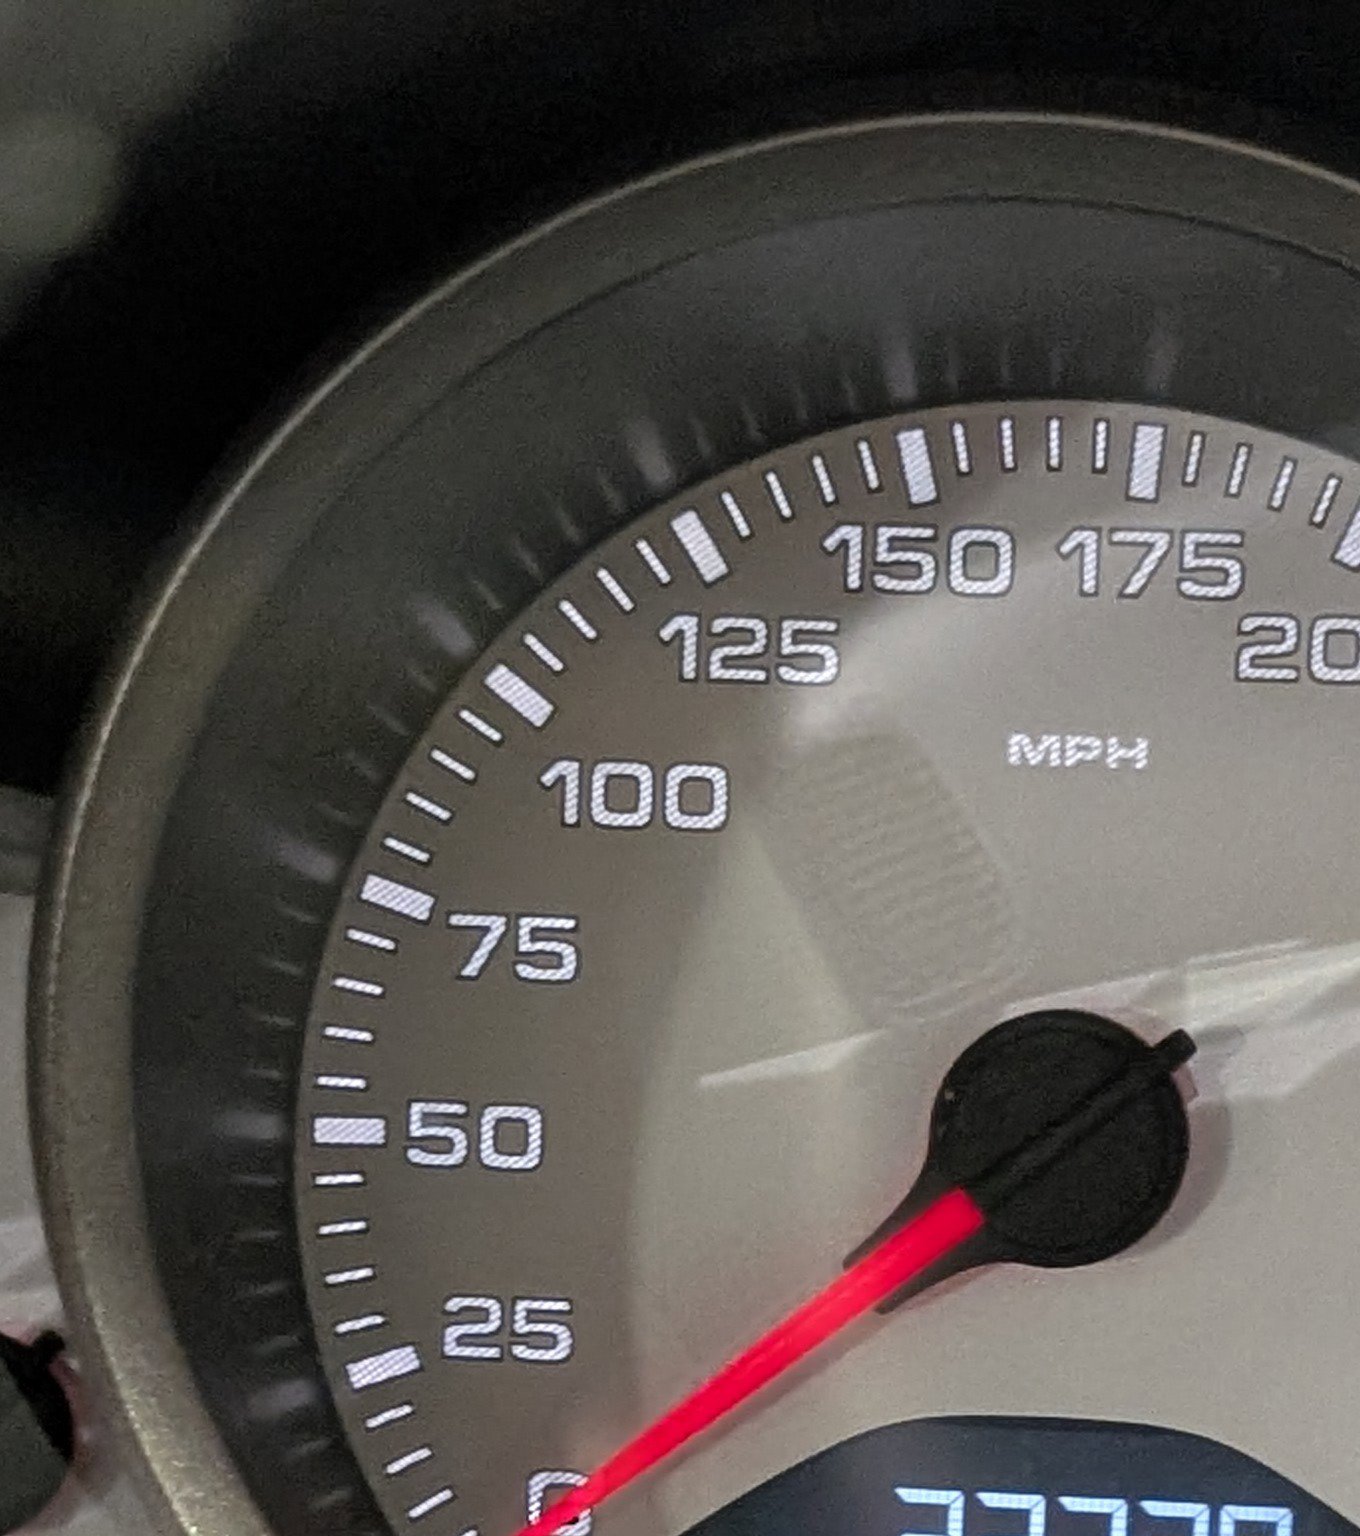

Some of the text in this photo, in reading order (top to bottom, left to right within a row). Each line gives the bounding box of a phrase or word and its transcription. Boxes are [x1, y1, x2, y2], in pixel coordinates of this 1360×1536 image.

[821, 524, 1016, 598] 150
[1058, 526, 1245, 600] 175
[657, 613, 842, 684] 125
[1006, 732, 1150, 770] MPH
[538, 758, 730, 831] 100
[447, 912, 580, 983] 75
[403, 1100, 544, 1170] 50
[441, 1296, 575, 1363] 25
